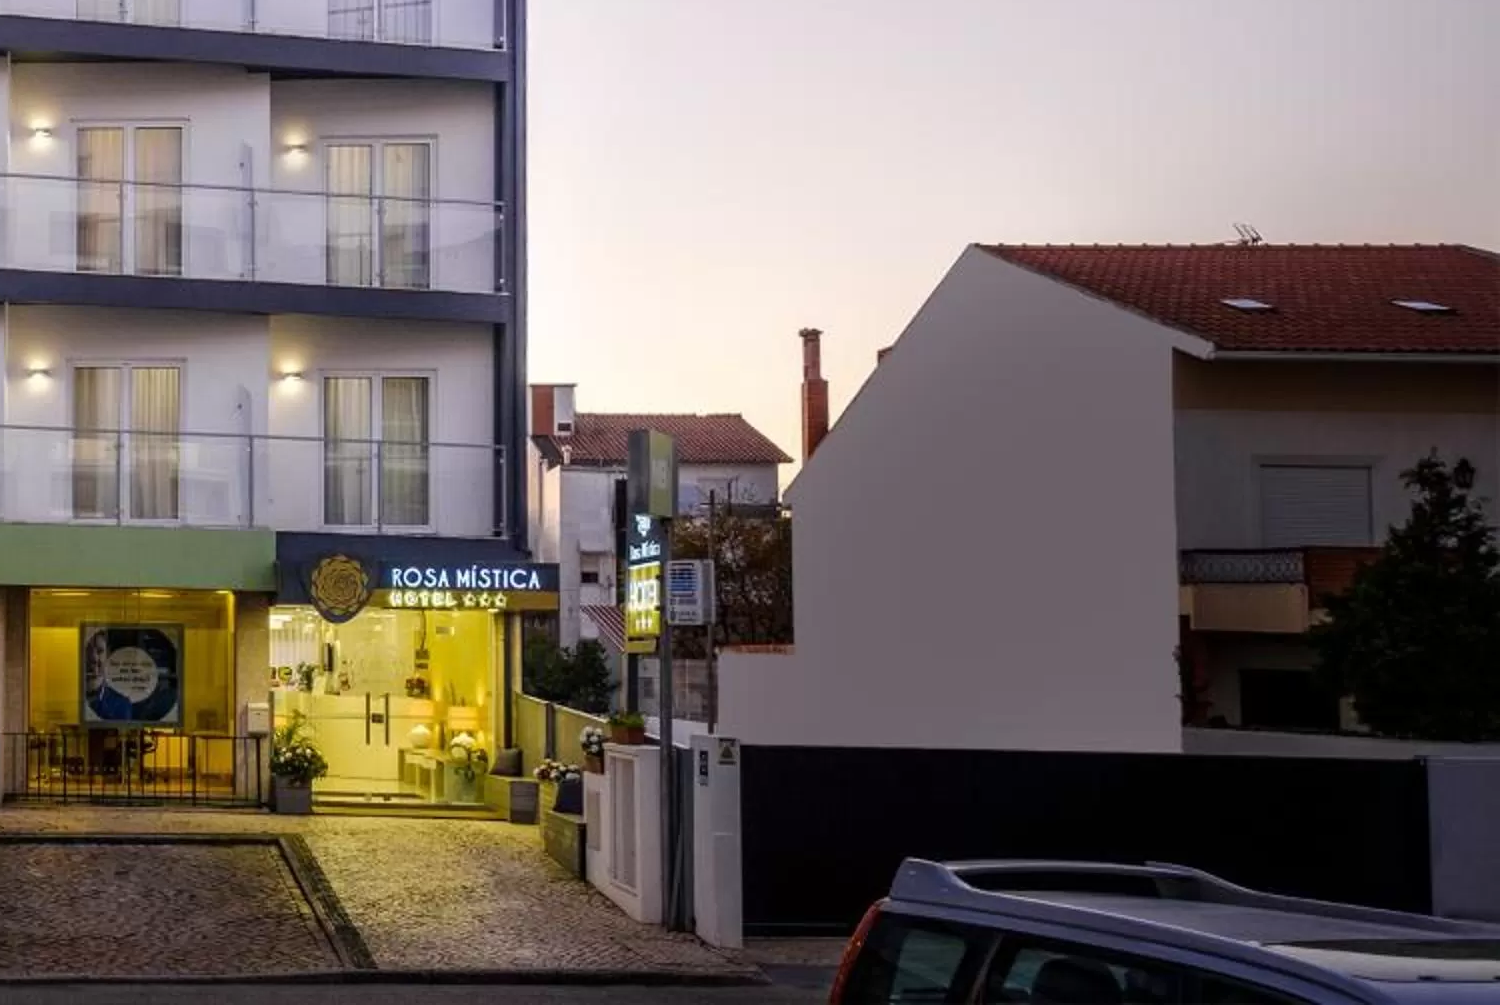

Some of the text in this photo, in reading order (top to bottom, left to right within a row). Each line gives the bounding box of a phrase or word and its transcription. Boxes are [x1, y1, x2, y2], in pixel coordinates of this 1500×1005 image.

[391, 565, 541, 589] ROSA MÍSTICA
[389, 589, 457, 608] HOTEL
